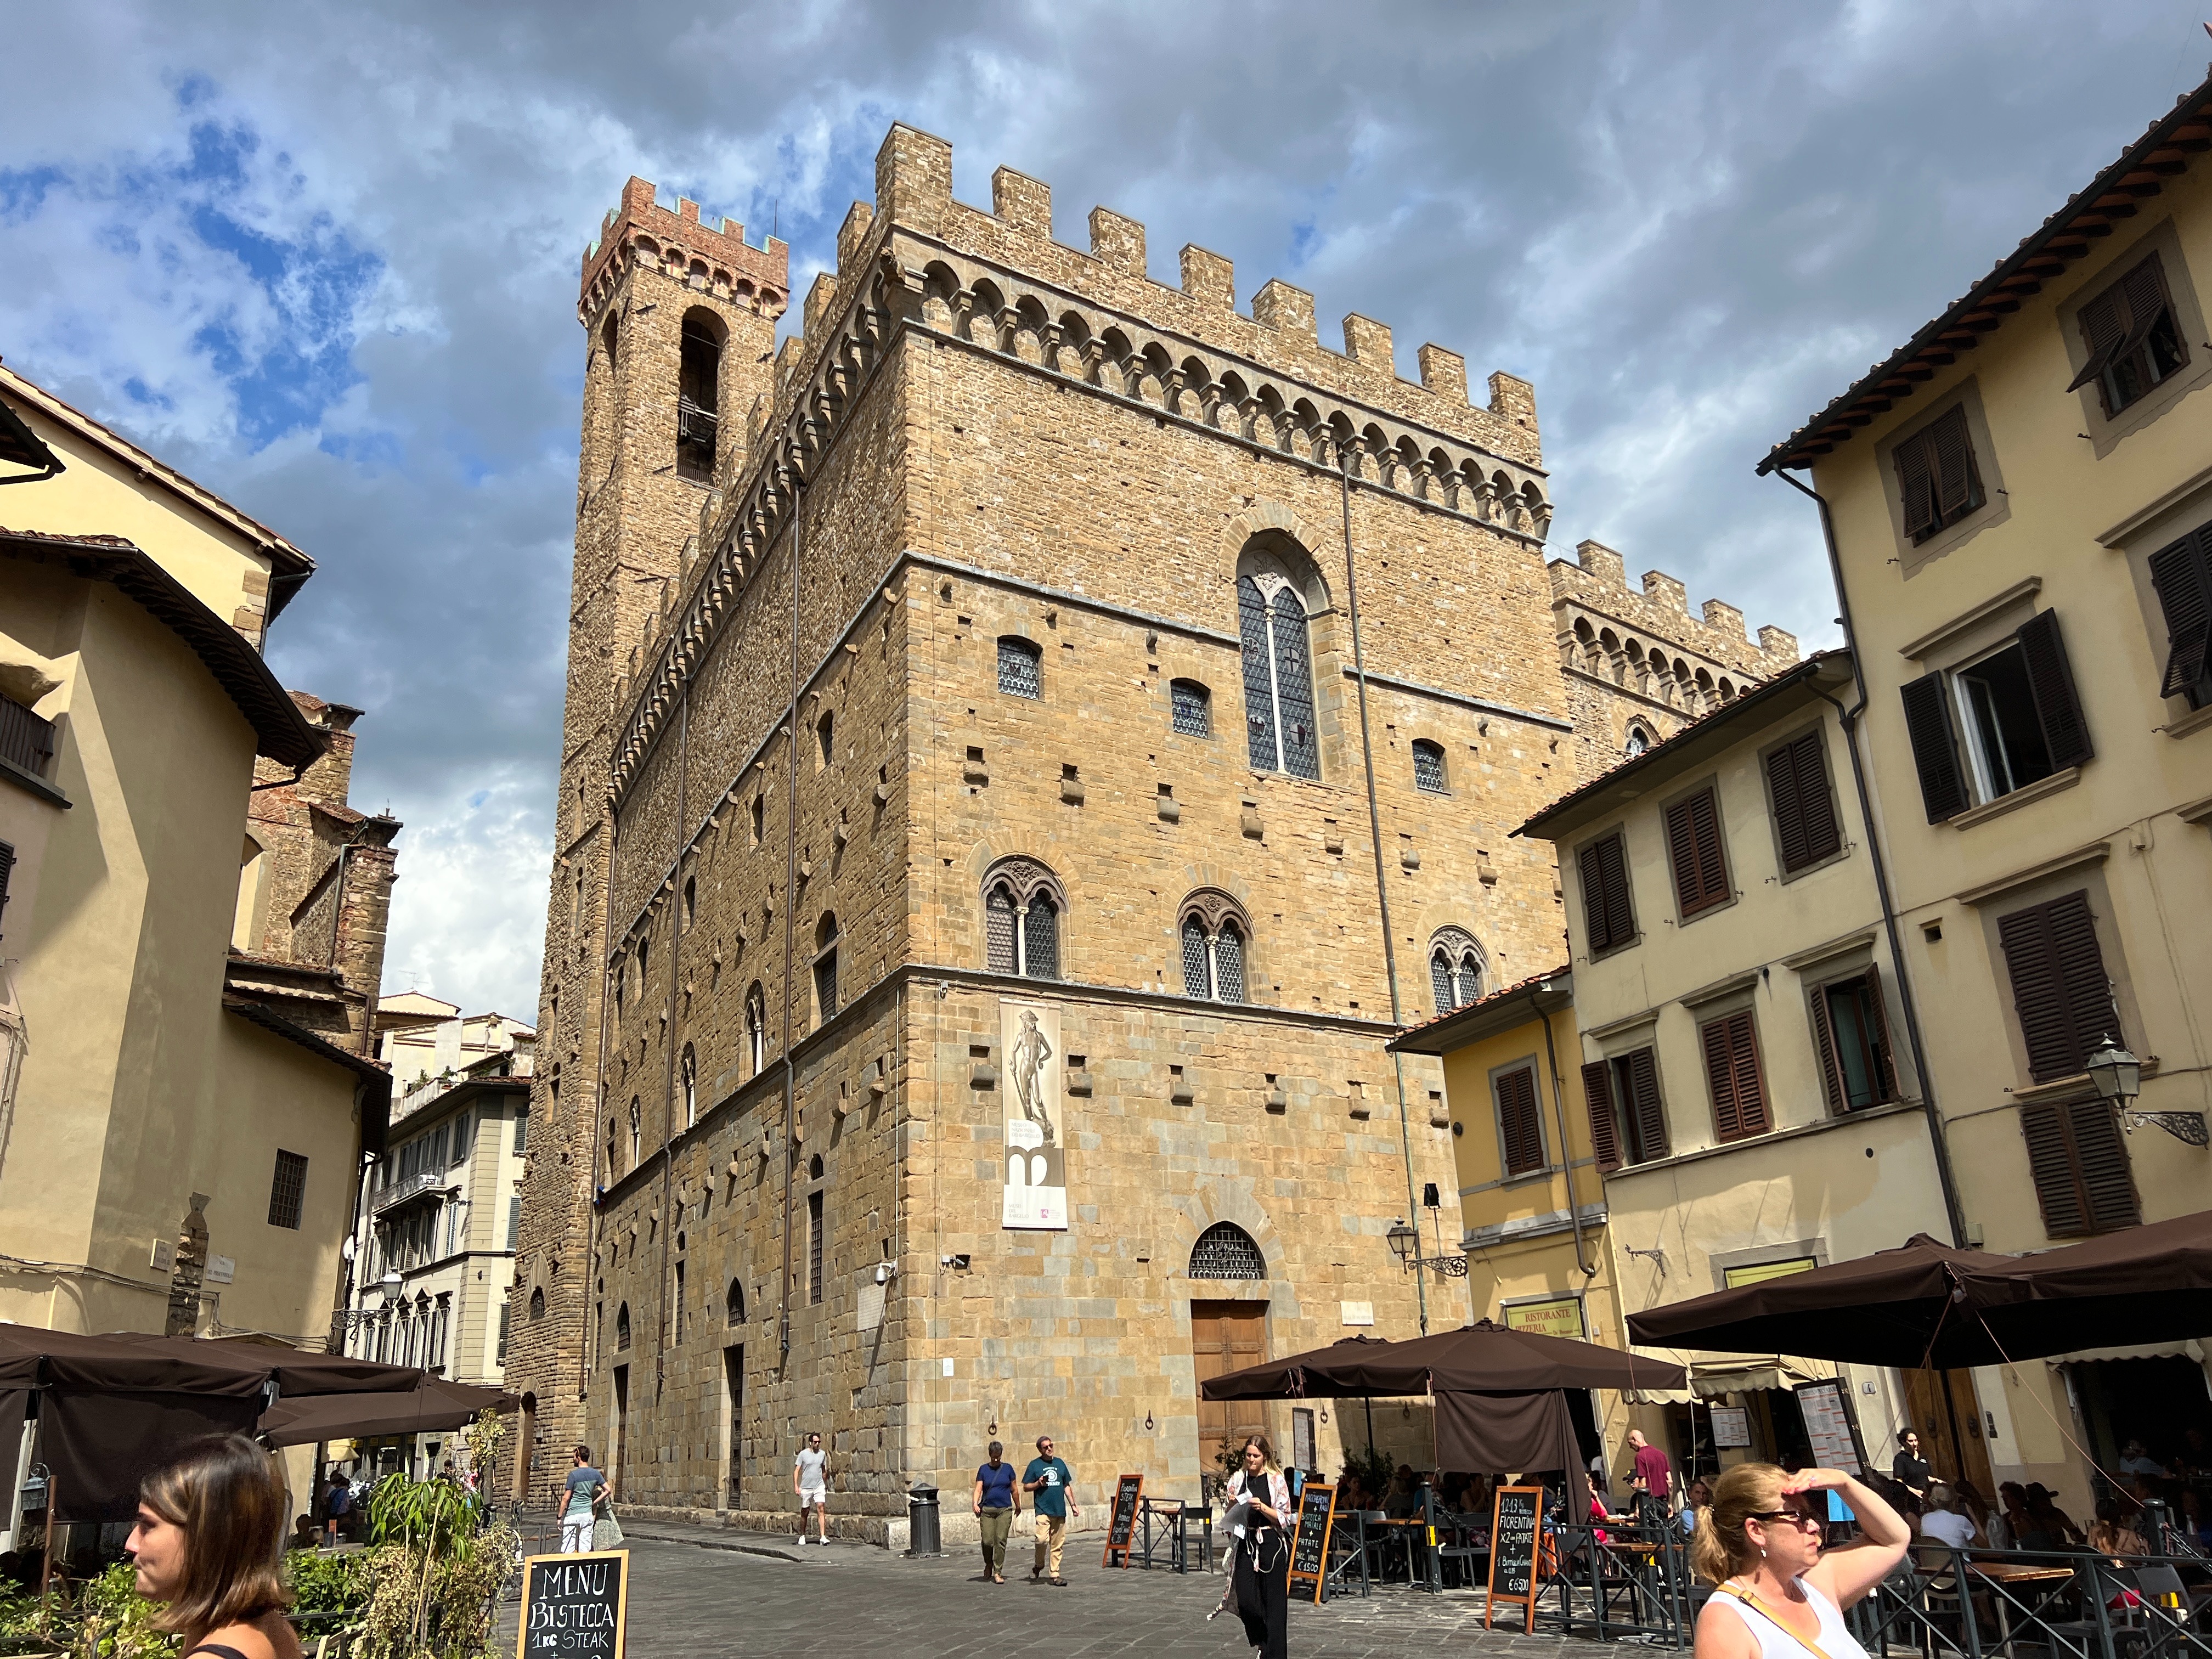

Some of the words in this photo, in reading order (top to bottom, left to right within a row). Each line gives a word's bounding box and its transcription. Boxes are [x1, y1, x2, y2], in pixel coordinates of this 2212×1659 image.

[1525, 1308, 1571, 1322] RISTORANTE
[1297, 1537, 1318, 1548] PATATE
[539, 1564, 608, 1599] MENU
[528, 1602, 614, 1629] BISTECCA
[532, 1632, 557, 1649] 1KG
[562, 1629, 608, 1649] STEAK
